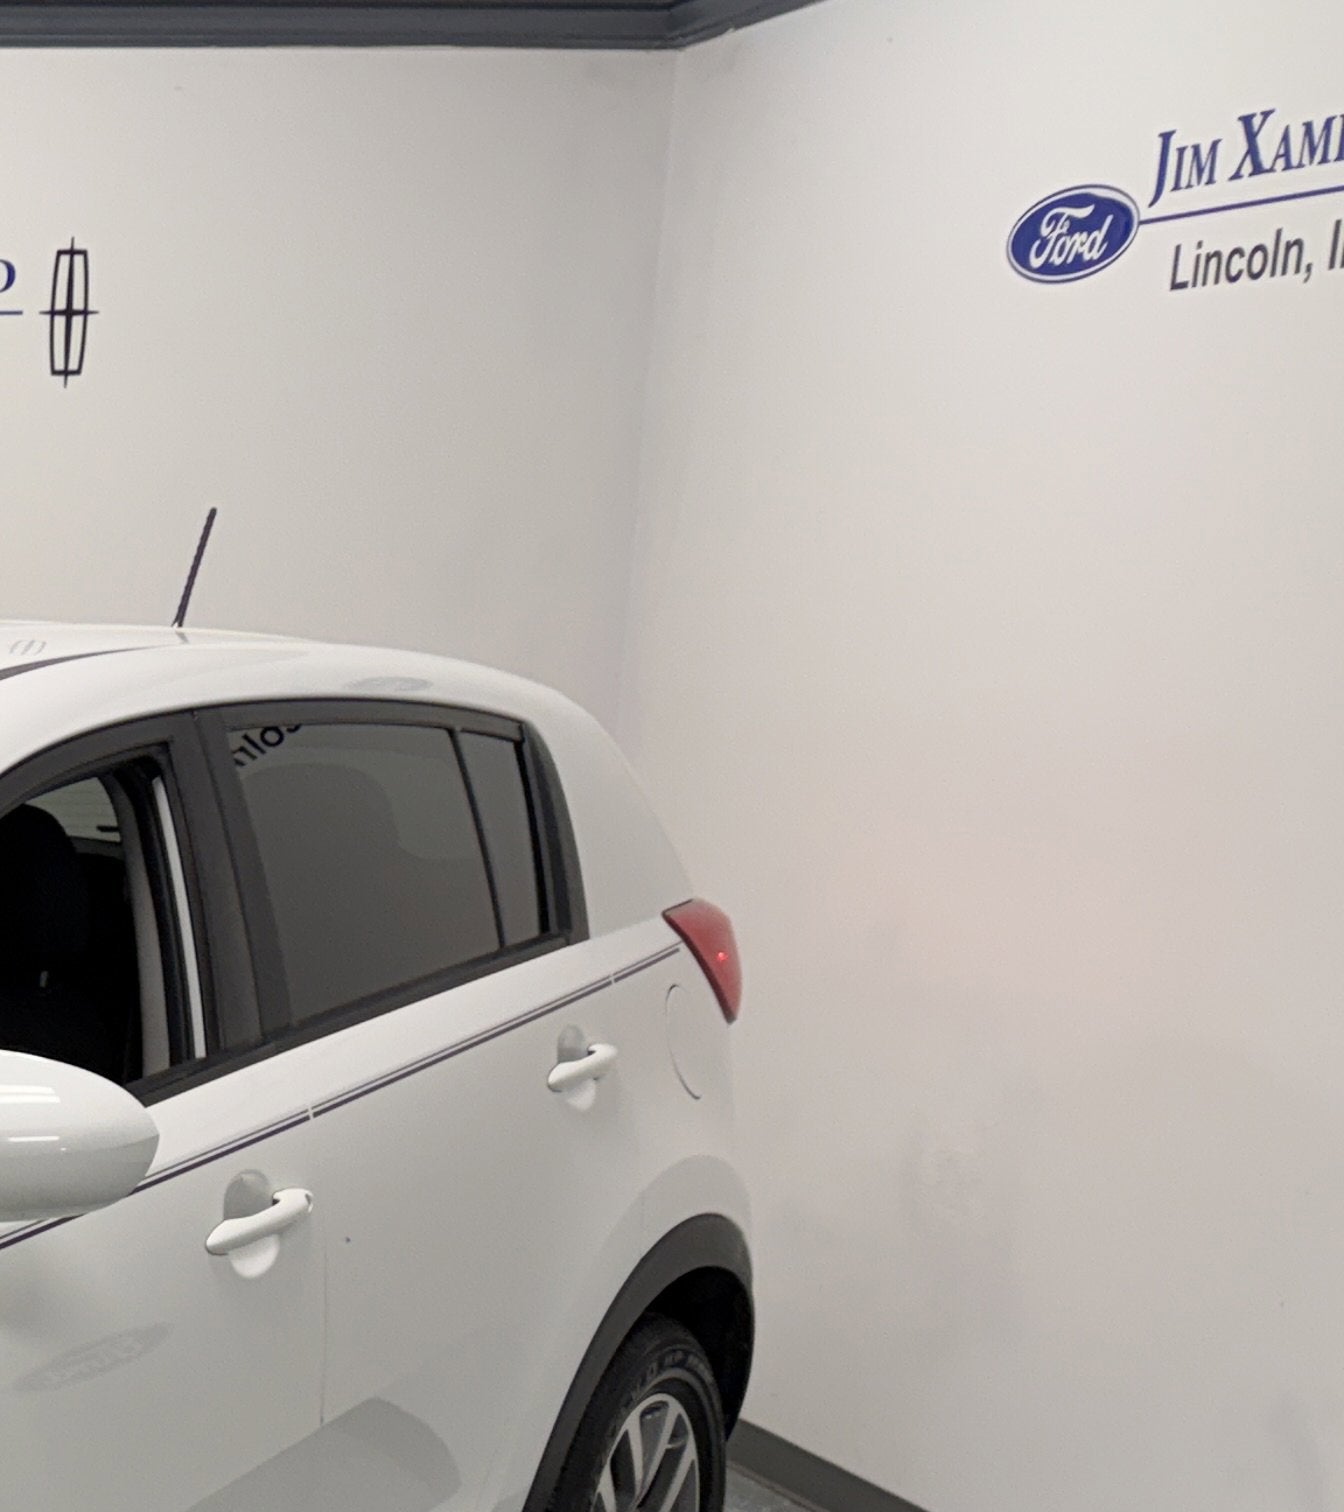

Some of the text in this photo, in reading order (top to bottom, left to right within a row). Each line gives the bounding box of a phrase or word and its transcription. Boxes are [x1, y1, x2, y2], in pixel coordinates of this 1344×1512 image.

[1148, 108, 1344, 208] JIM XAMI
[1029, 204, 1114, 269] Ford
[1170, 227, 1314, 291] Lincoln,
